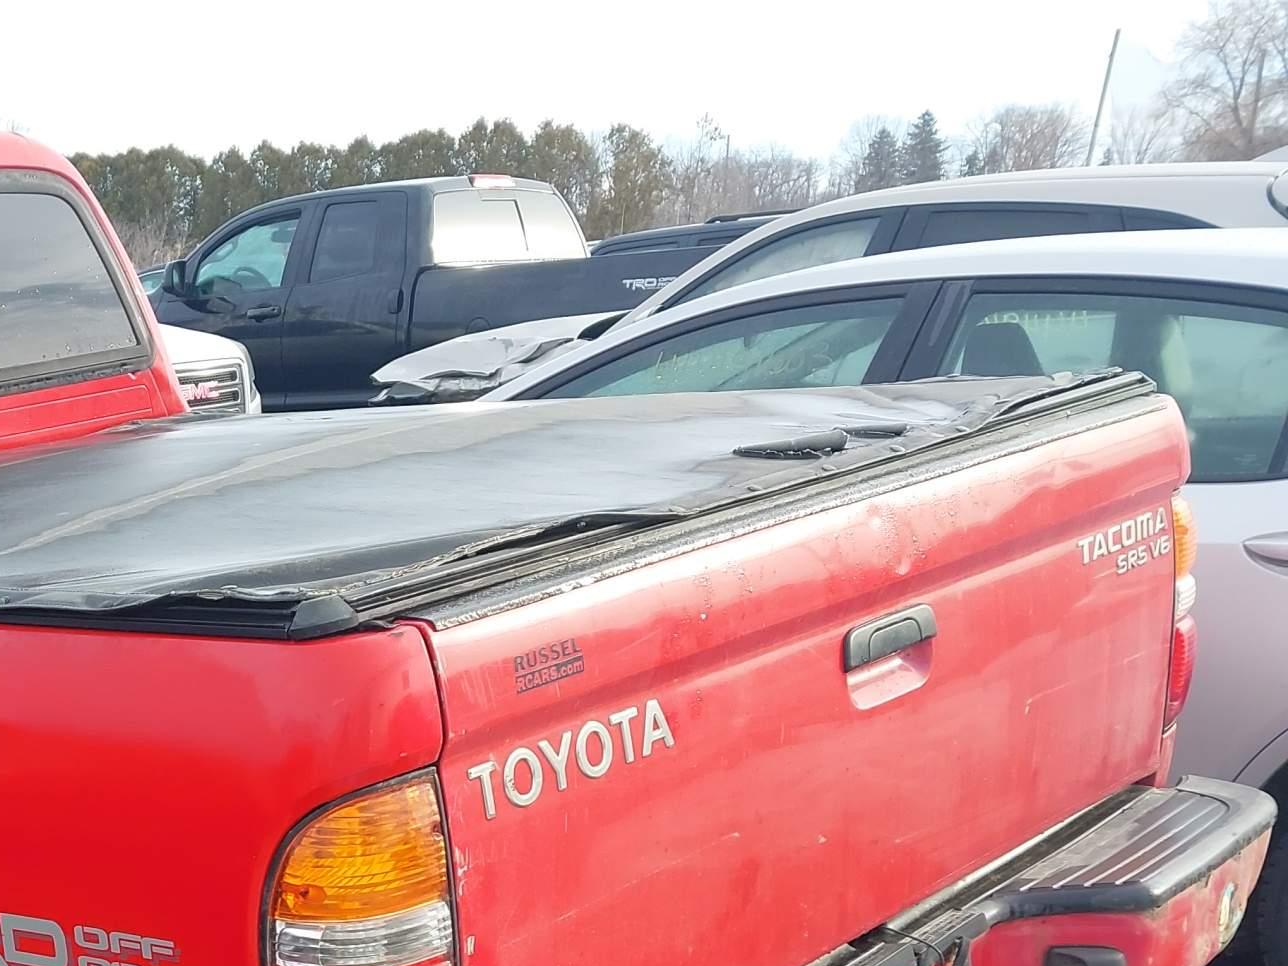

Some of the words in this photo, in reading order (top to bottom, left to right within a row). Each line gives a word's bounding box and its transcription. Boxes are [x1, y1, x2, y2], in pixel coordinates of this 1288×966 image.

[1077, 506, 1168, 565] TACOMA
[1116, 545, 1148, 575] SR5
[1150, 535, 1171, 559] V6
[514, 638, 583, 673] RUSSEL
[467, 698, 675, 820] TOYOTA
[74, 924, 175, 961] OFF
